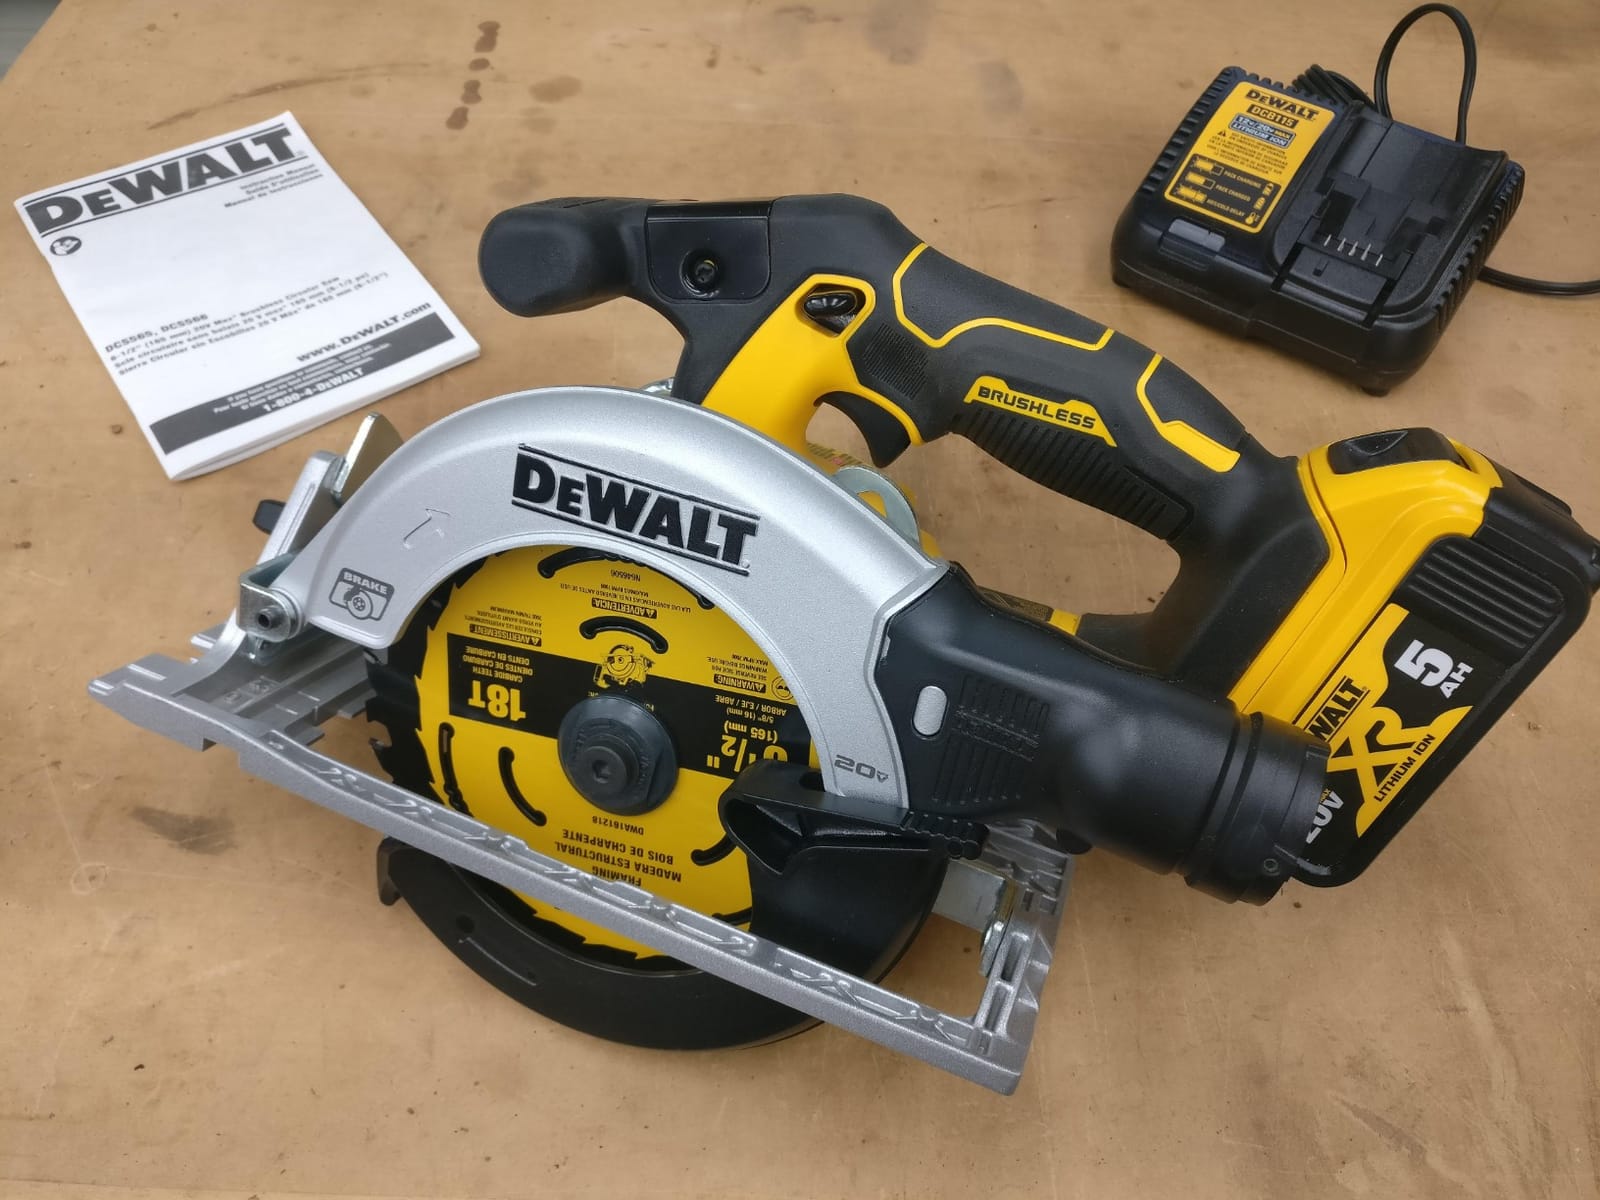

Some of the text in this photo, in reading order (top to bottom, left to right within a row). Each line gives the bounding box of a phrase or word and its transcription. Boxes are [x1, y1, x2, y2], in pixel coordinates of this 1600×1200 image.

[1250, 106, 1296, 127] DCB115
[1232, 122, 1286, 146] LITHIUM ION
[978, 386, 1095, 429] BRUSHLESS
[343, 571, 388, 594] BRAKE
[461, 654, 533, 675] DIENTES DE CARBURO
[464, 645, 529, 665] DENTS EN CARBURE
[473, 666, 523, 683] CARBIDE TEETH
[1394, 639, 1473, 698] 5 AH
[468, 680, 526, 721] 18T
[714, 694, 734, 704] ABRE
[740, 700, 754, 708] EJE
[760, 704, 786, 715] ARBOR
[1309, 678, 1363, 739] WALT
[726, 706, 774, 723] 5/8" (16 mm)
[722, 719, 778, 743] (165 mm)
[1373, 733, 1435, 802] LITHIUM ION
[592, 816, 645, 835] DWA161218
[562, 829, 674, 865] BOIS DE CHARPENTE
[554, 841, 682, 882] MADERA ESTRUCTURAL
[592, 866, 642, 887] FRAMING
